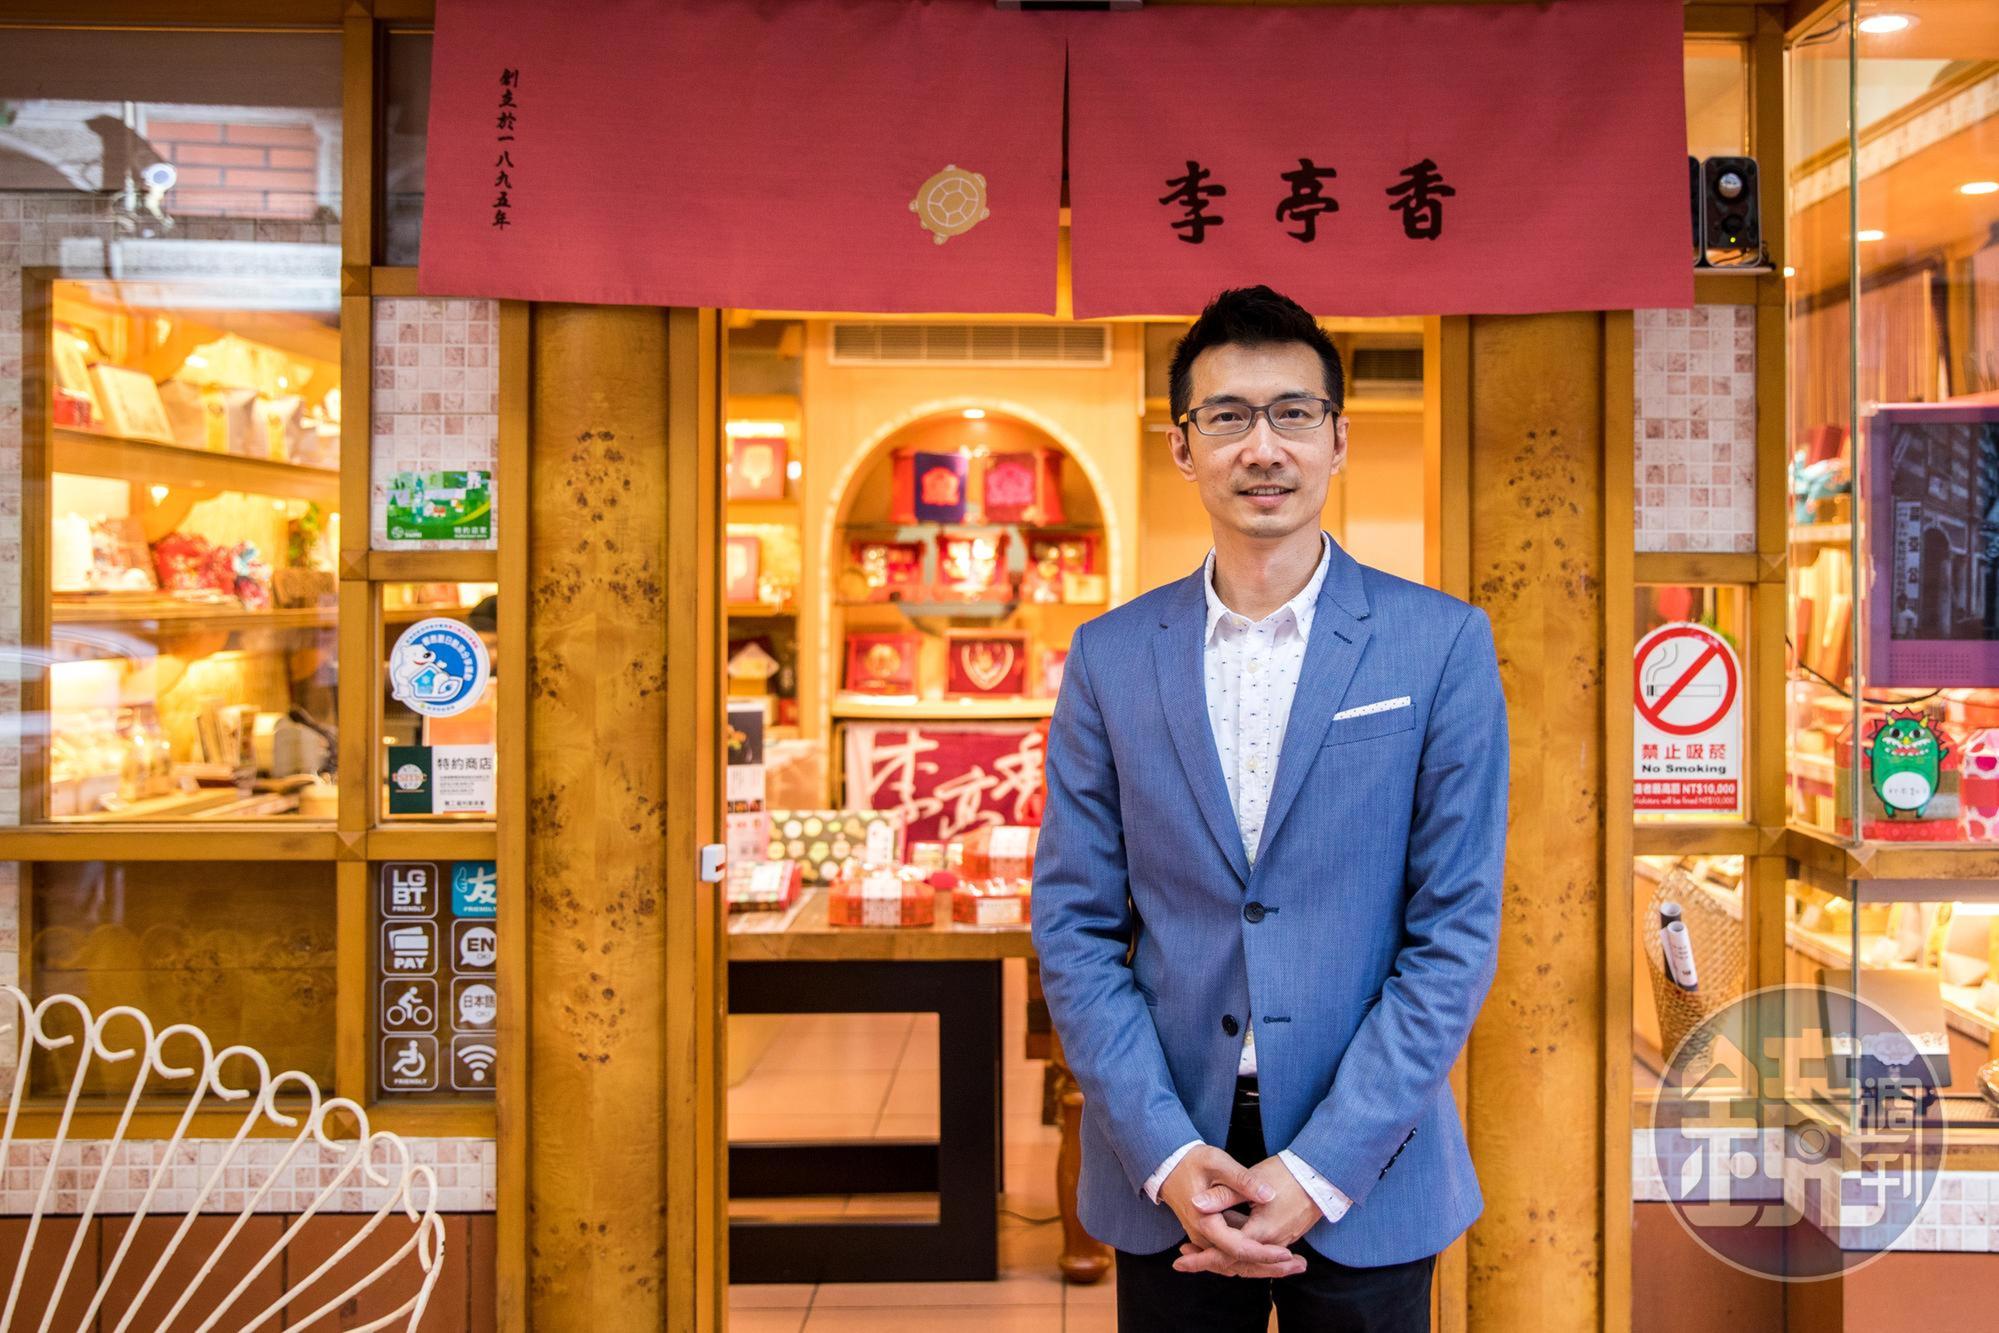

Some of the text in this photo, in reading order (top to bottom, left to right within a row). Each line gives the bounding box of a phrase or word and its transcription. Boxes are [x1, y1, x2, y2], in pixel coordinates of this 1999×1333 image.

[492, 68, 519, 230] 創立於一八九五年
[1158, 158, 1456, 244] 李亭香
[1641, 743, 1726, 760] 禁止吸菸
[437, 757, 492, 770] 特約商店
[1641, 764, 1727, 775] No Smoking
[1682, 783, 1735, 795] NT$10,000
[392, 869, 427, 887] LG
[464, 867, 497, 905] 友
[392, 887, 427, 905] BT
[467, 938, 495, 952] EN
[394, 958, 427, 969] PAY
[464, 995, 496, 1008] 日本語
